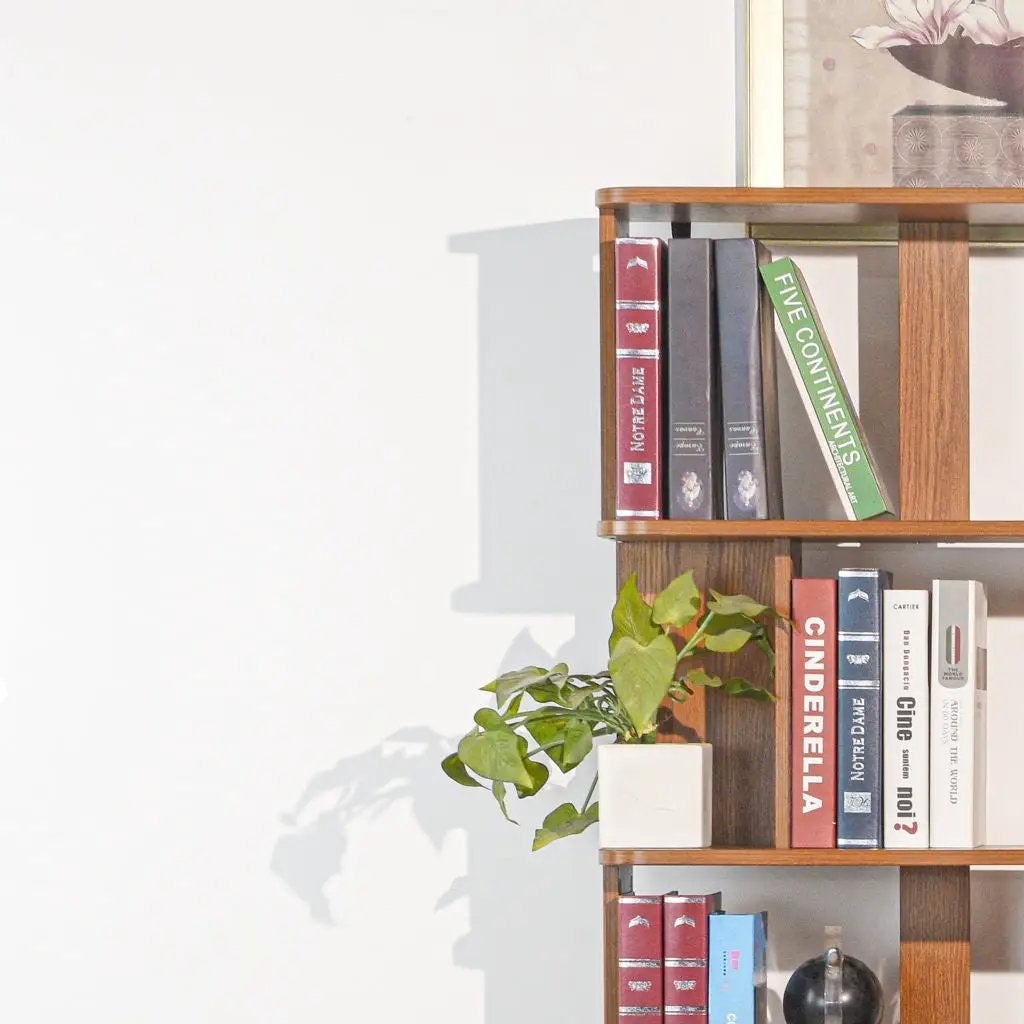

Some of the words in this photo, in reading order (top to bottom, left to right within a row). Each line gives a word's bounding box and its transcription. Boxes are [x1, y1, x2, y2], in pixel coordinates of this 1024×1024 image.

[630, 367, 645, 405] DAME
[774, 272, 808, 324] FIVE
[795, 326, 861, 467] CONTINENTS
[630, 407, 645, 452] NOTRE
[903, 630, 911, 646] Dan
[802, 616, 826, 814] CINDERELLA
[849, 697, 865, 735] DAME
[896, 697, 916, 741] Cine
[950, 700, 960, 743] AROUND
[849, 737, 865, 782] NOTRE
[901, 749, 911, 779] suntem
[950, 746, 960, 765] THE
[950, 769, 960, 805] WORLD
[893, 787, 918, 835] noi?
